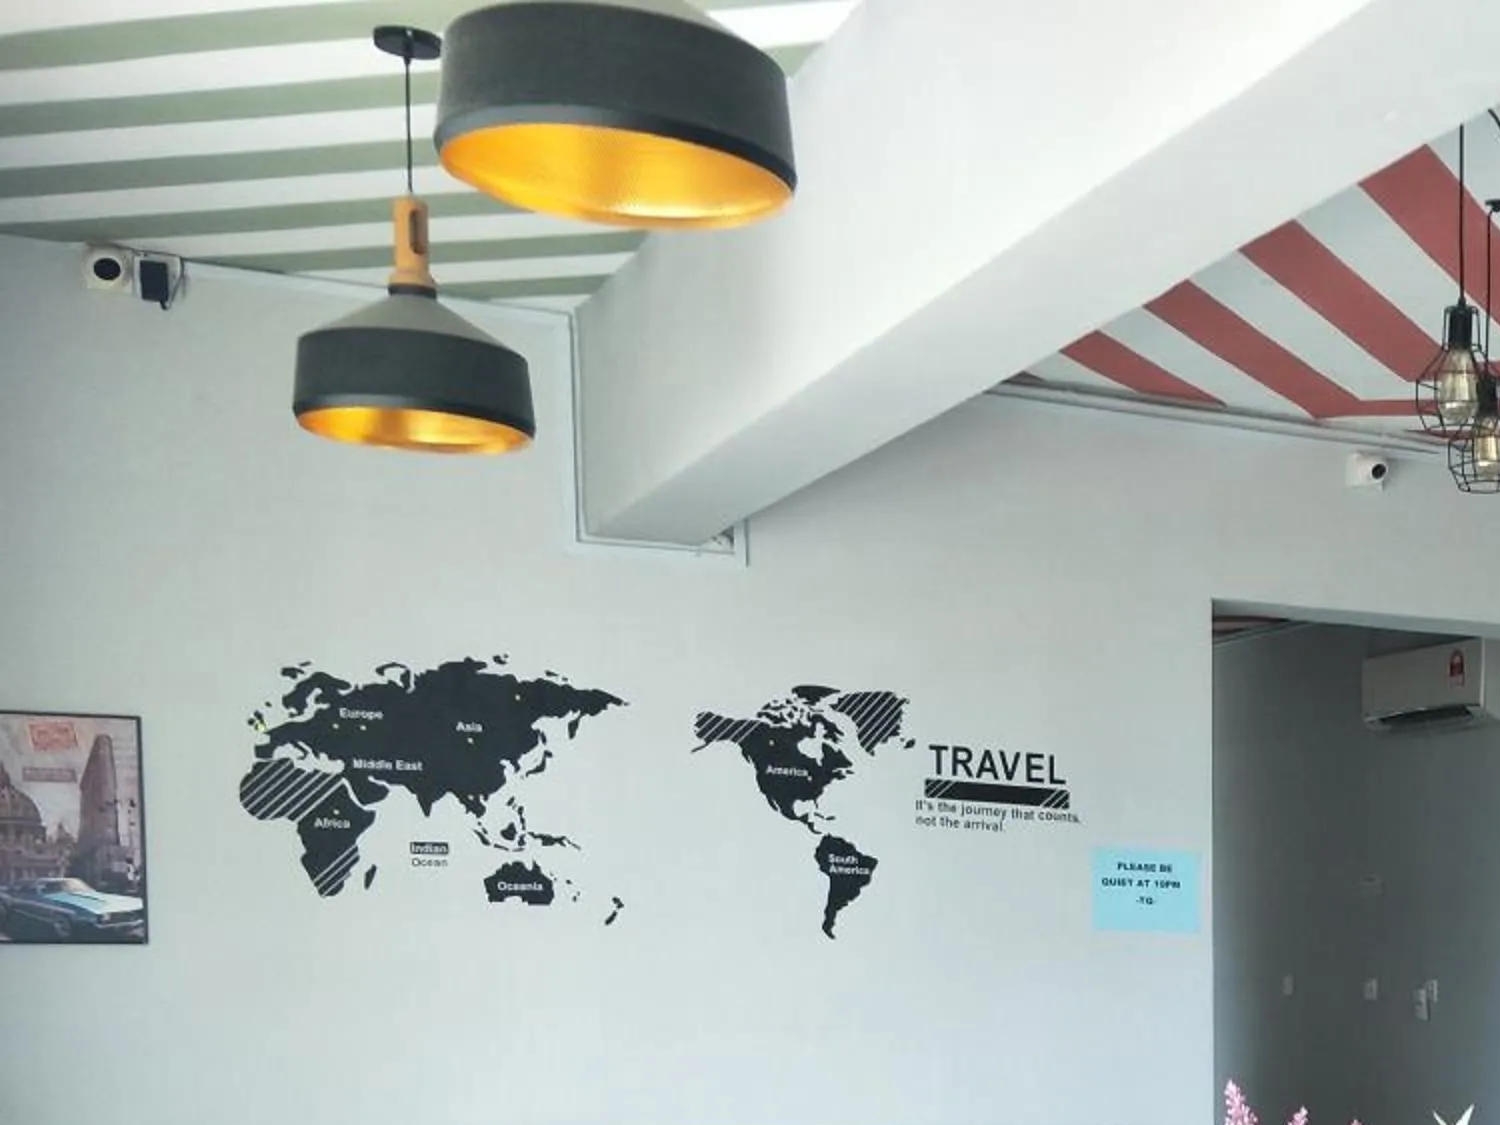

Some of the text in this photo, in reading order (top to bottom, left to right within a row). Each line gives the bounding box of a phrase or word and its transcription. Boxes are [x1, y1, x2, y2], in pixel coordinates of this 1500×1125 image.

[339, 707, 384, 720] Europe
[456, 721, 483, 733] Asia
[353, 758, 423, 771] Middle East
[928, 744, 1067, 785] TRAVEL
[766, 765, 808, 777] America
[937, 802, 957, 814] the
[960, 804, 1007, 821] journey
[1011, 808, 1035, 821] that
[314, 817, 351, 830] Africa
[915, 816, 937, 828] not
[939, 816, 960, 829] the
[410, 843, 449, 854] Indian
[411, 857, 449, 868] Ocean
[828, 854, 859, 865] South
[829, 864, 871, 876] America
[1117, 862, 1157, 873] PLEASE
[496, 881, 544, 893] Oceania
[1101, 877, 1134, 888] QUIET
[1136, 879, 1151, 889] AT
